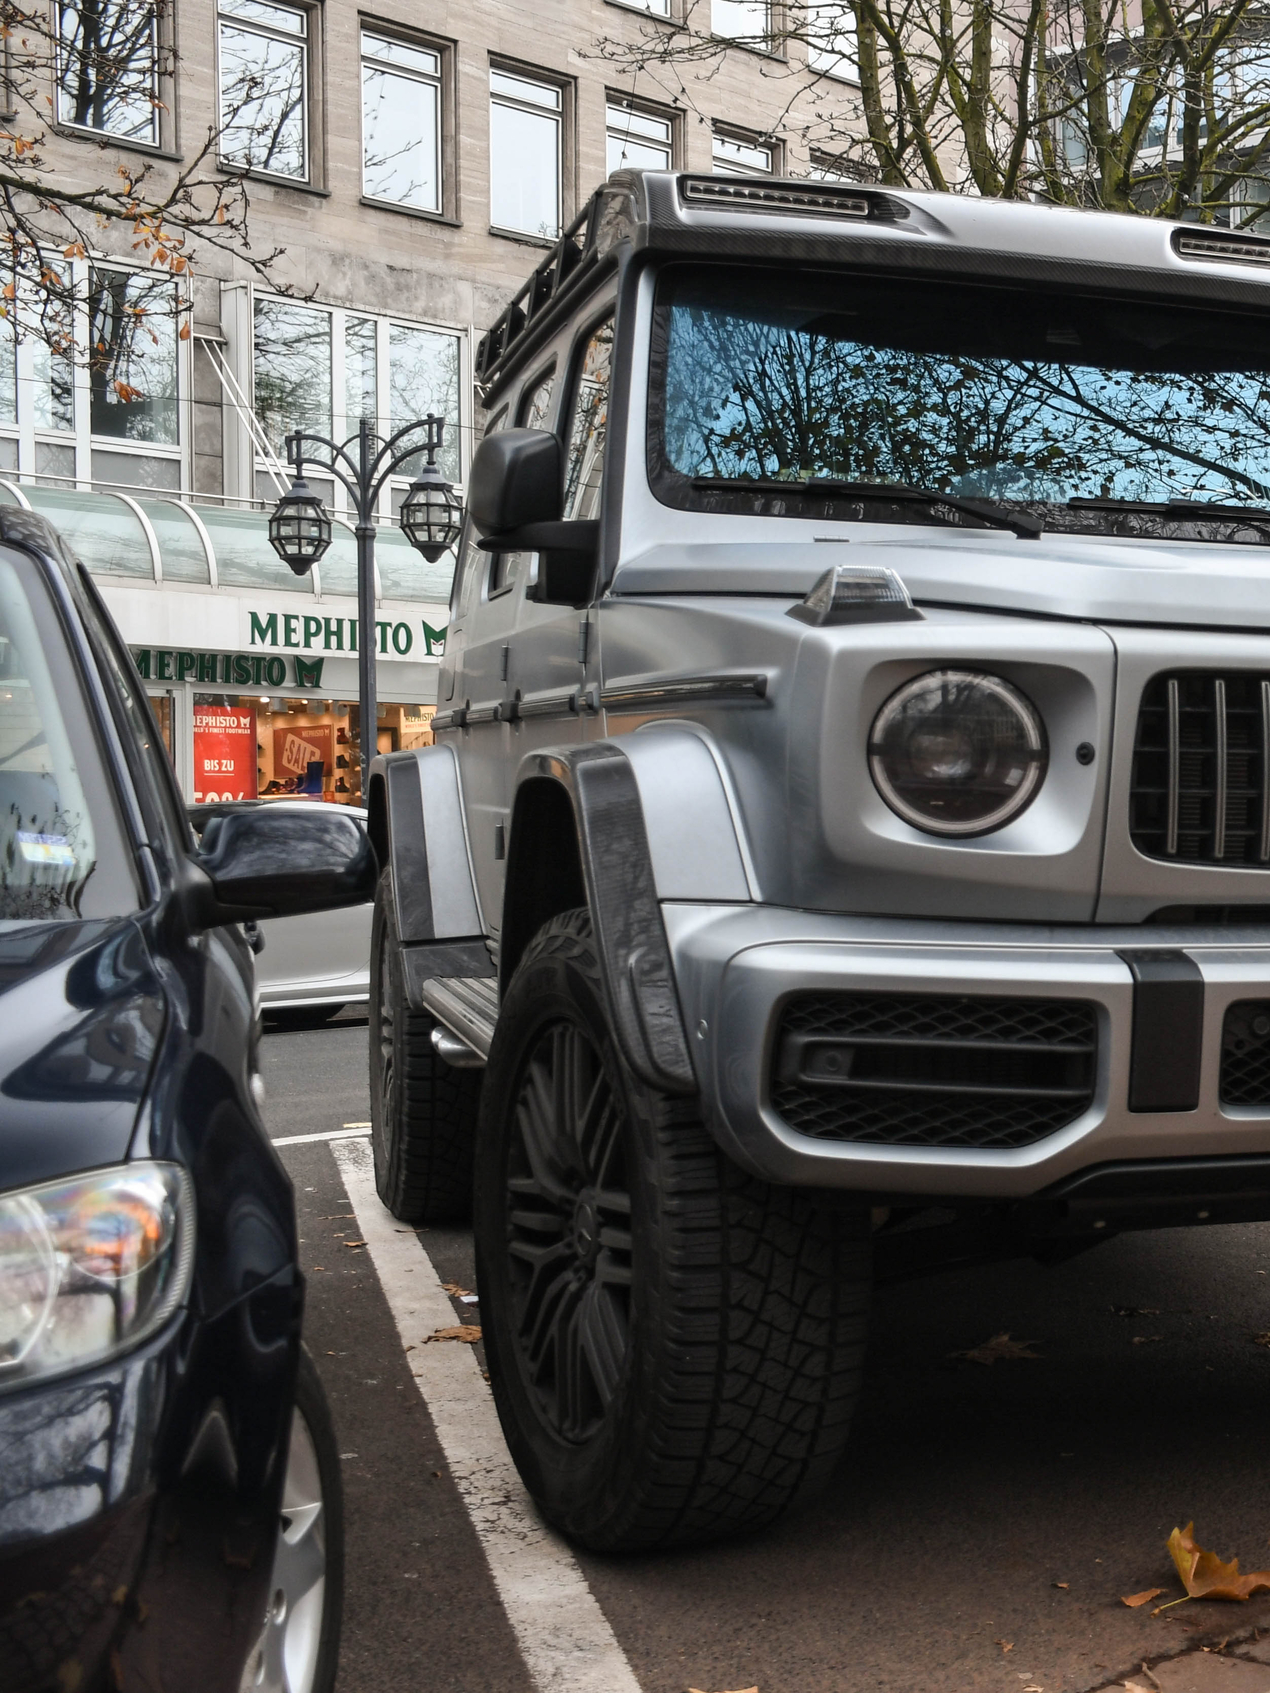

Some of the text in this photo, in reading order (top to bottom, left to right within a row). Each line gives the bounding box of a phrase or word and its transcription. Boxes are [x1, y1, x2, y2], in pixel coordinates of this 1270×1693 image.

[249, 611, 414, 655] MEPHITO
[137, 649, 287, 687] MEPHISTO
[204, 760, 234, 771] BIS ZU
